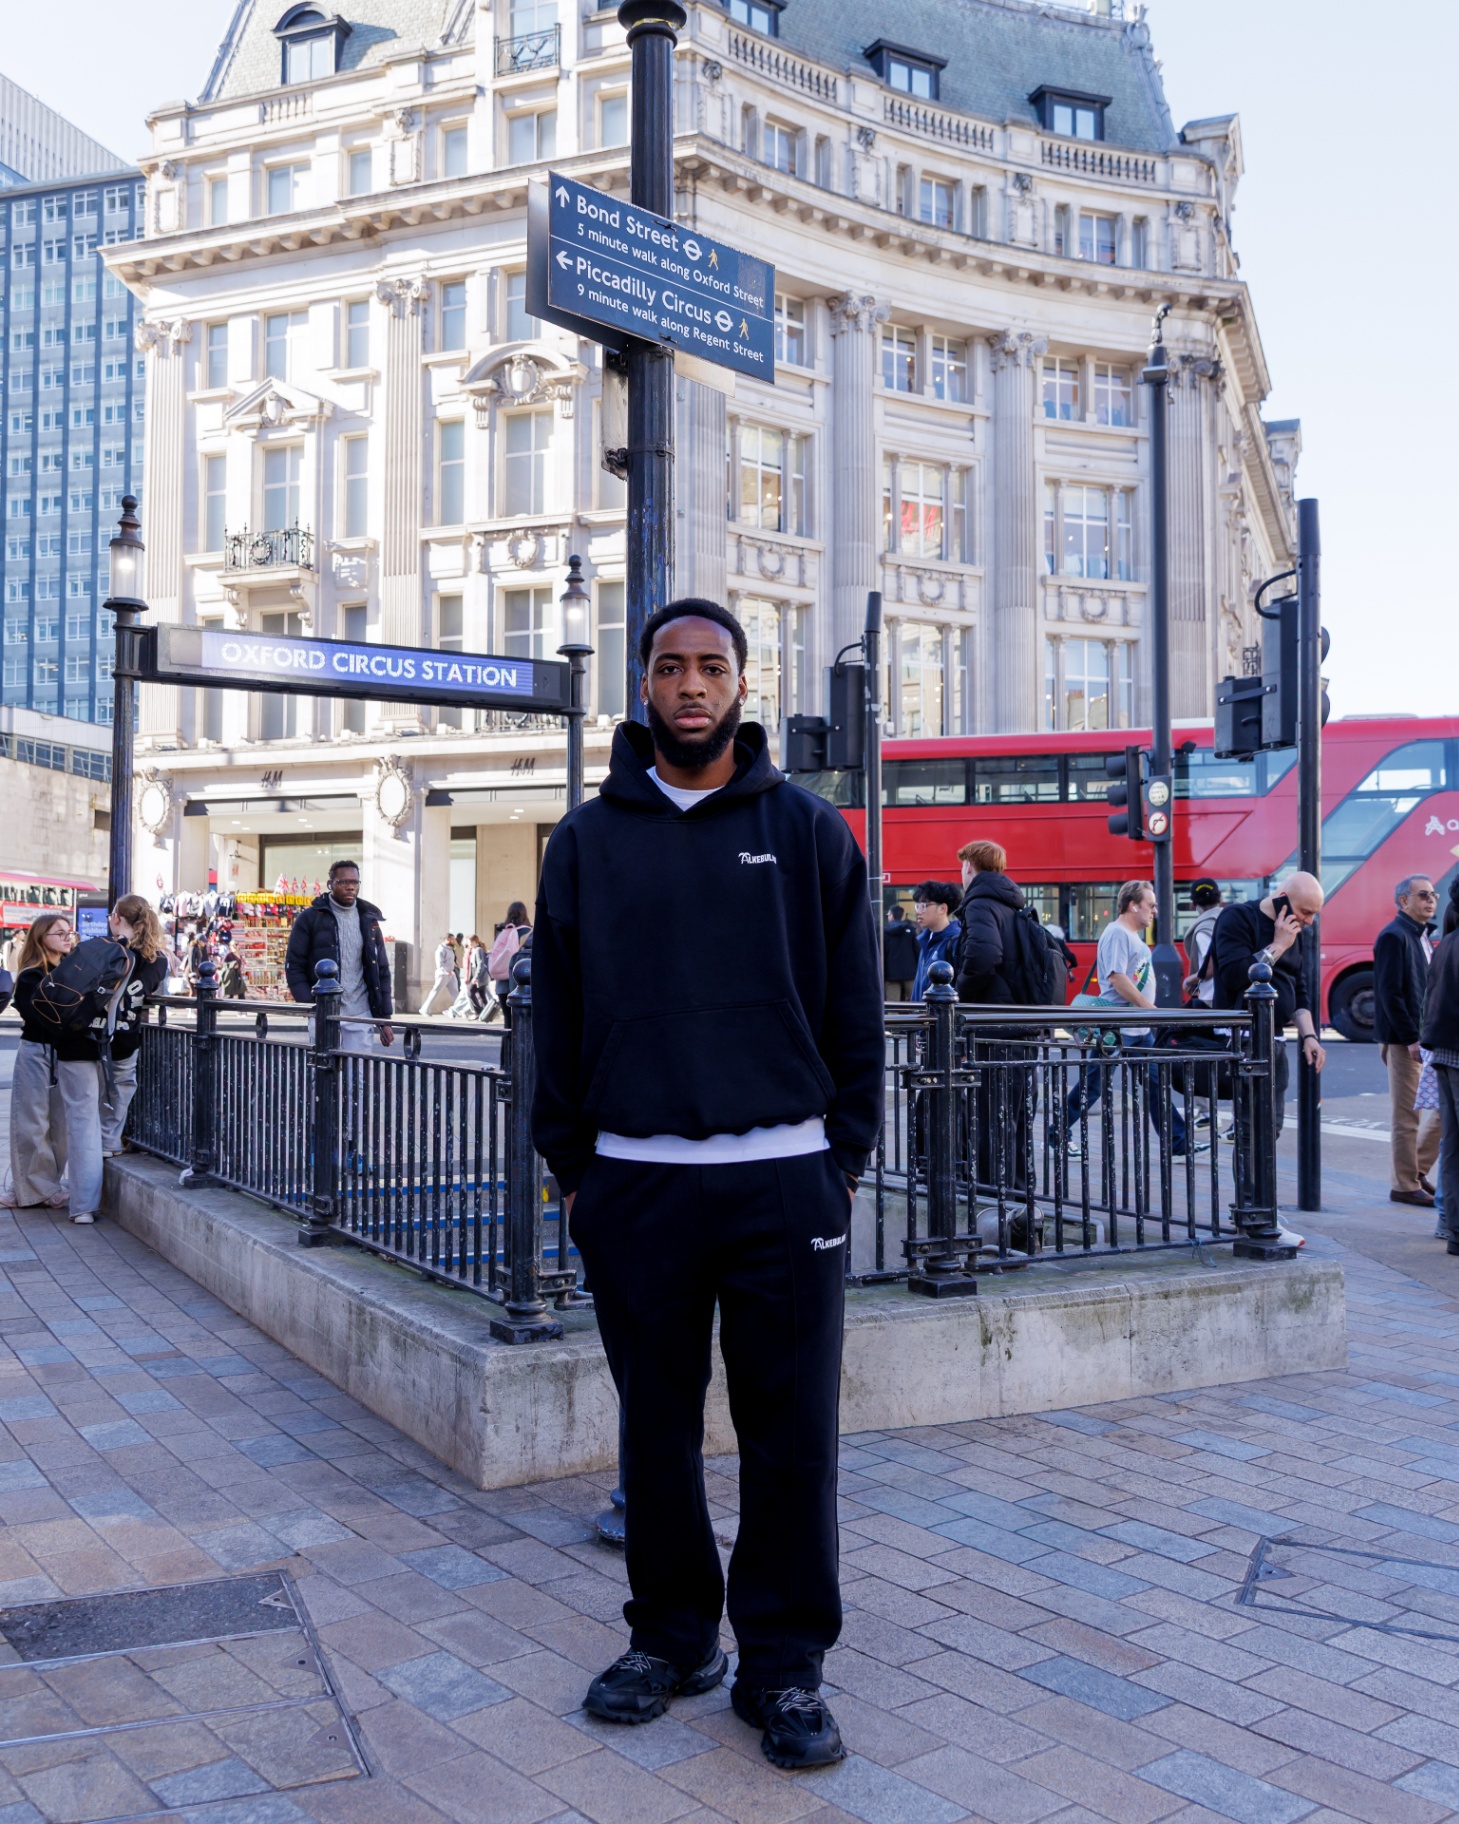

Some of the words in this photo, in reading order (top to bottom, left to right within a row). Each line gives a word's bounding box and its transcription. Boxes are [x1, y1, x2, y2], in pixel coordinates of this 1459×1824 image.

[577, 195, 620, 228] Bond
[626, 216, 679, 252] Street
[576, 256, 657, 306] Piccadilly
[661, 291, 712, 324] Circus
[577, 223, 584, 236] 5
[588, 230, 629, 254] minute
[632, 246, 658, 265] walk
[660, 257, 690, 281] along
[693, 271, 731, 294] Oxford
[733, 285, 764, 308] Street
[577, 283, 584, 296] 9
[588, 289, 629, 313] minute
[632, 305, 658, 325] walk
[660, 315, 690, 338] along
[693, 329, 731, 351] Regent
[733, 341, 764, 363] Street
[221, 642, 326, 671] OXFORD
[332, 651, 416, 679] CIRCUS
[421, 659, 518, 688] STATION
